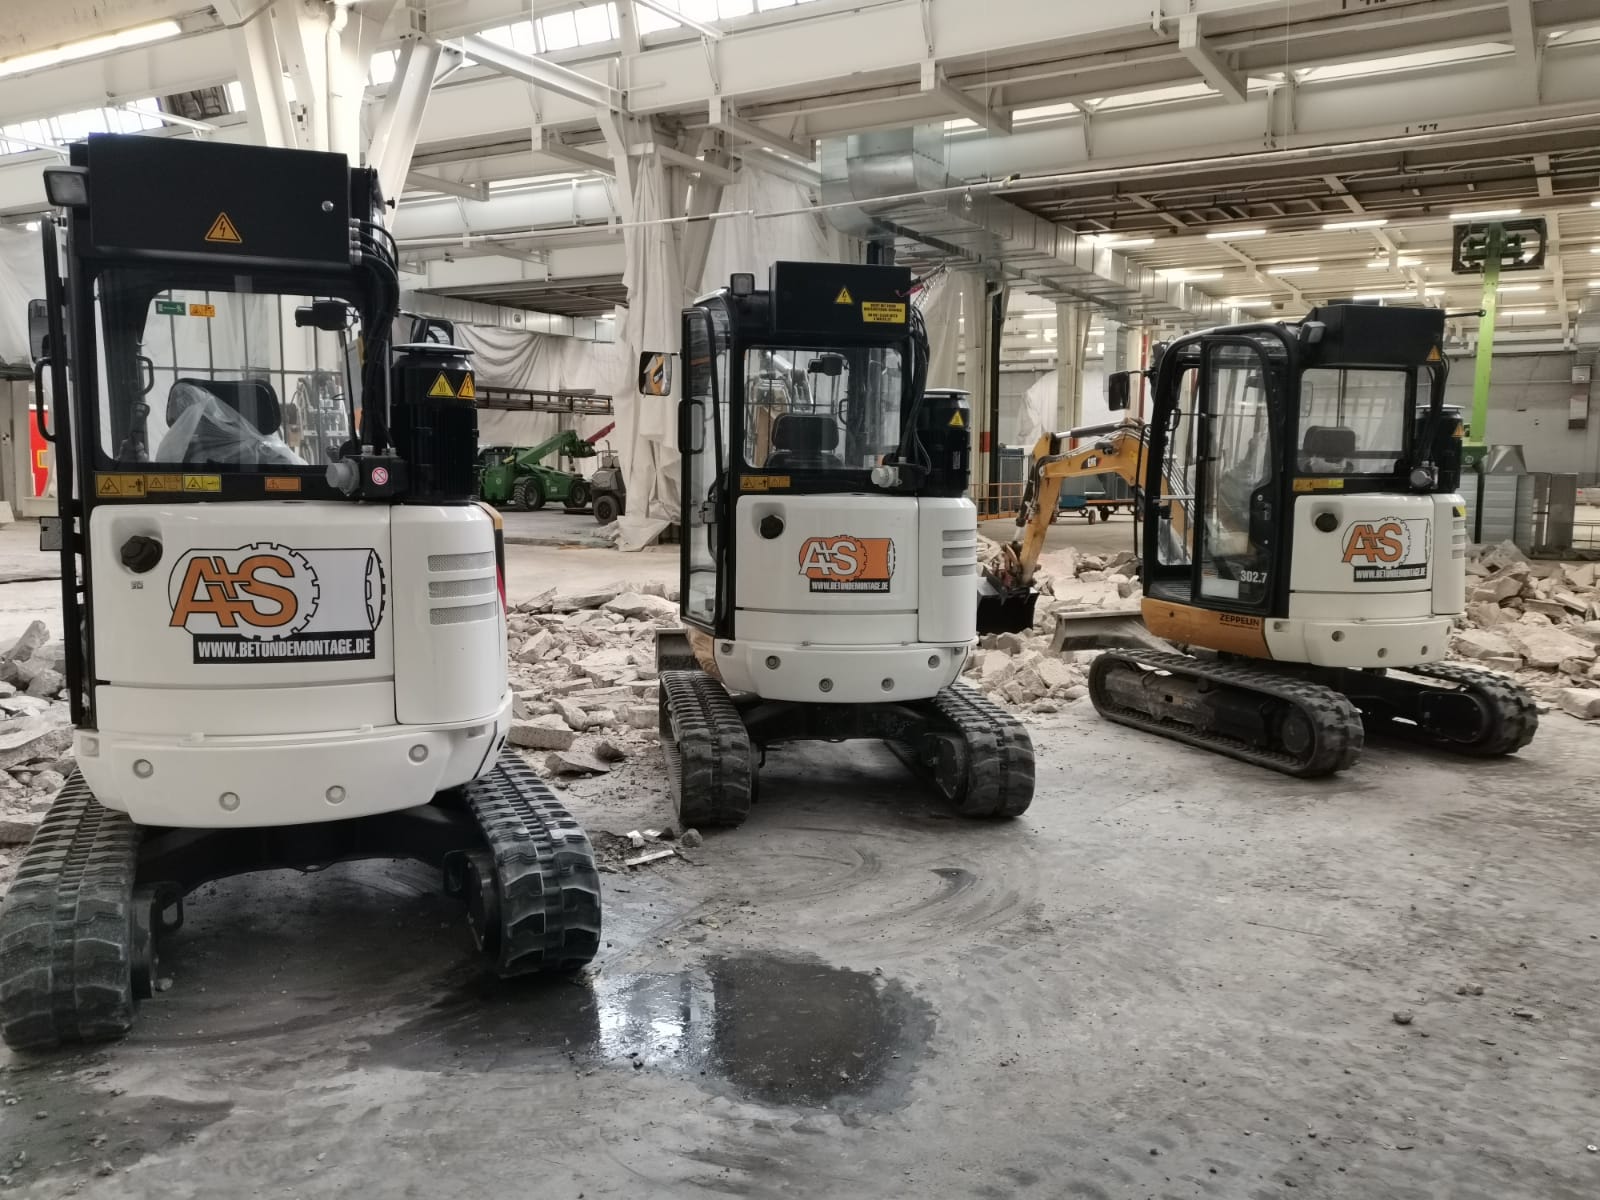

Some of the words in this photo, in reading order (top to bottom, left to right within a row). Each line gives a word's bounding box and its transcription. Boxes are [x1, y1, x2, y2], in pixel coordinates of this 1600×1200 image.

[1241, 570, 1267, 583] 302.7
[1355, 567, 1427, 579] WWW.BETETAGE.DE
[1220, 614, 1260, 627] ZEPPELIN
